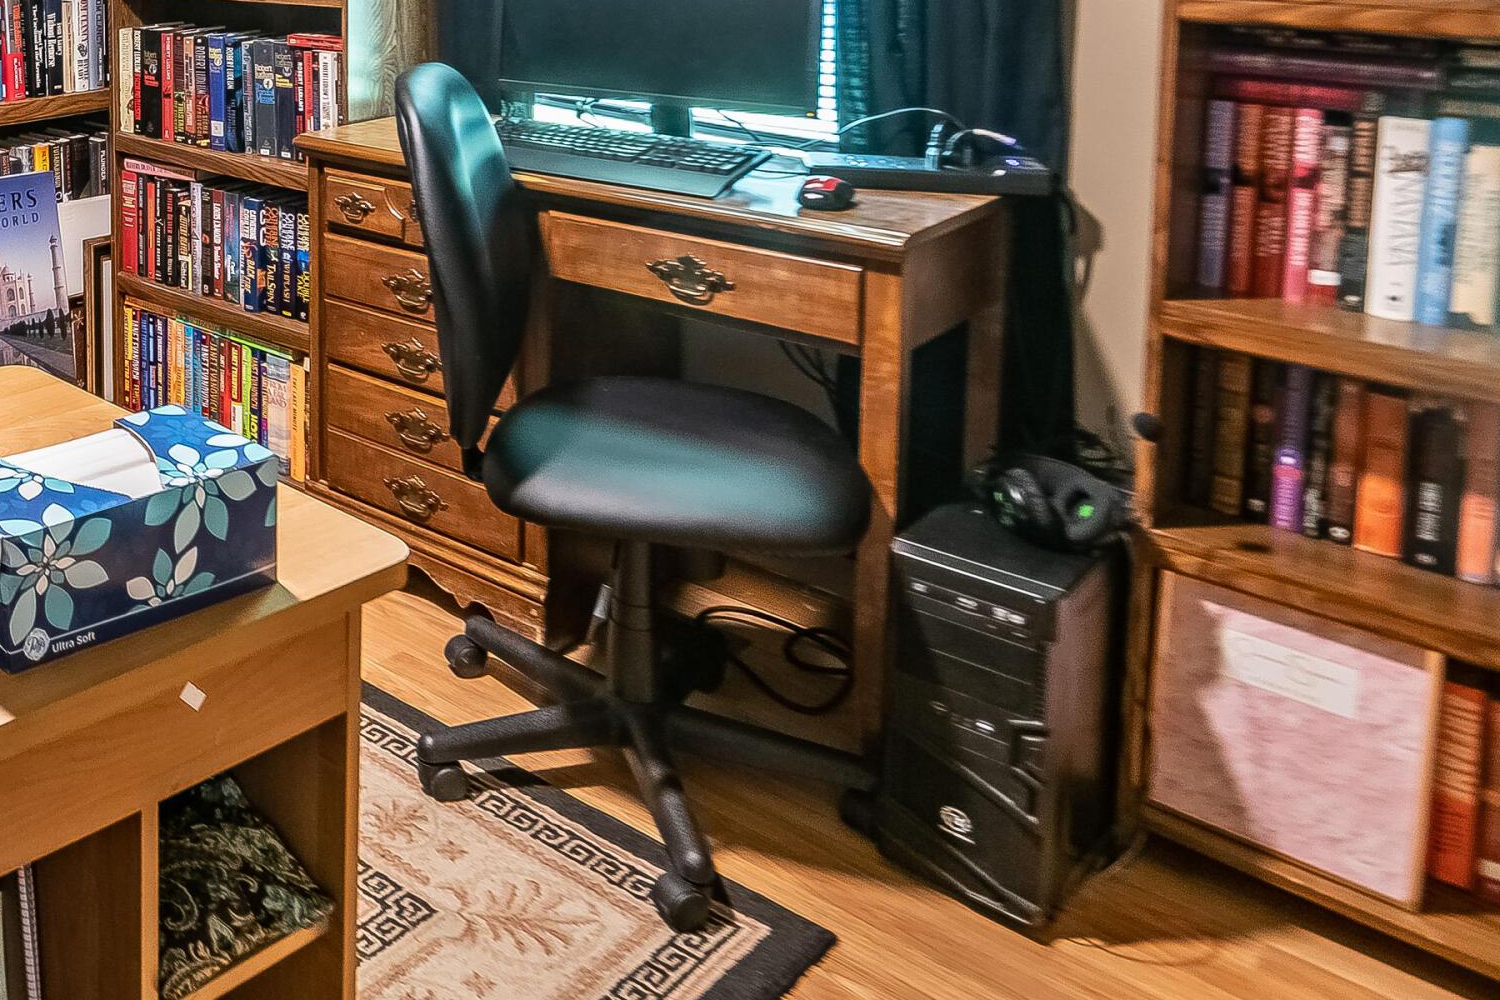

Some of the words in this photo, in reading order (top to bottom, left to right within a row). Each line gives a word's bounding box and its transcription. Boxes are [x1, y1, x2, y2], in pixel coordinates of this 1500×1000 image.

[47, 39, 56, 67] Remorse
[195, 46, 205, 69] ROBERT
[226, 47, 234, 66] ROBERT
[226, 67, 235, 90] LUDLUM
[209, 341, 218, 366] JANET
[231, 347, 239, 366] JANET
[210, 367, 218, 413] EVANOVICH
[251, 376, 259, 409] EVANOVICH
[250, 414, 258, 438] HOT
[52, 640, 75, 653] Ultra
[76, 631, 96, 645] Soft
